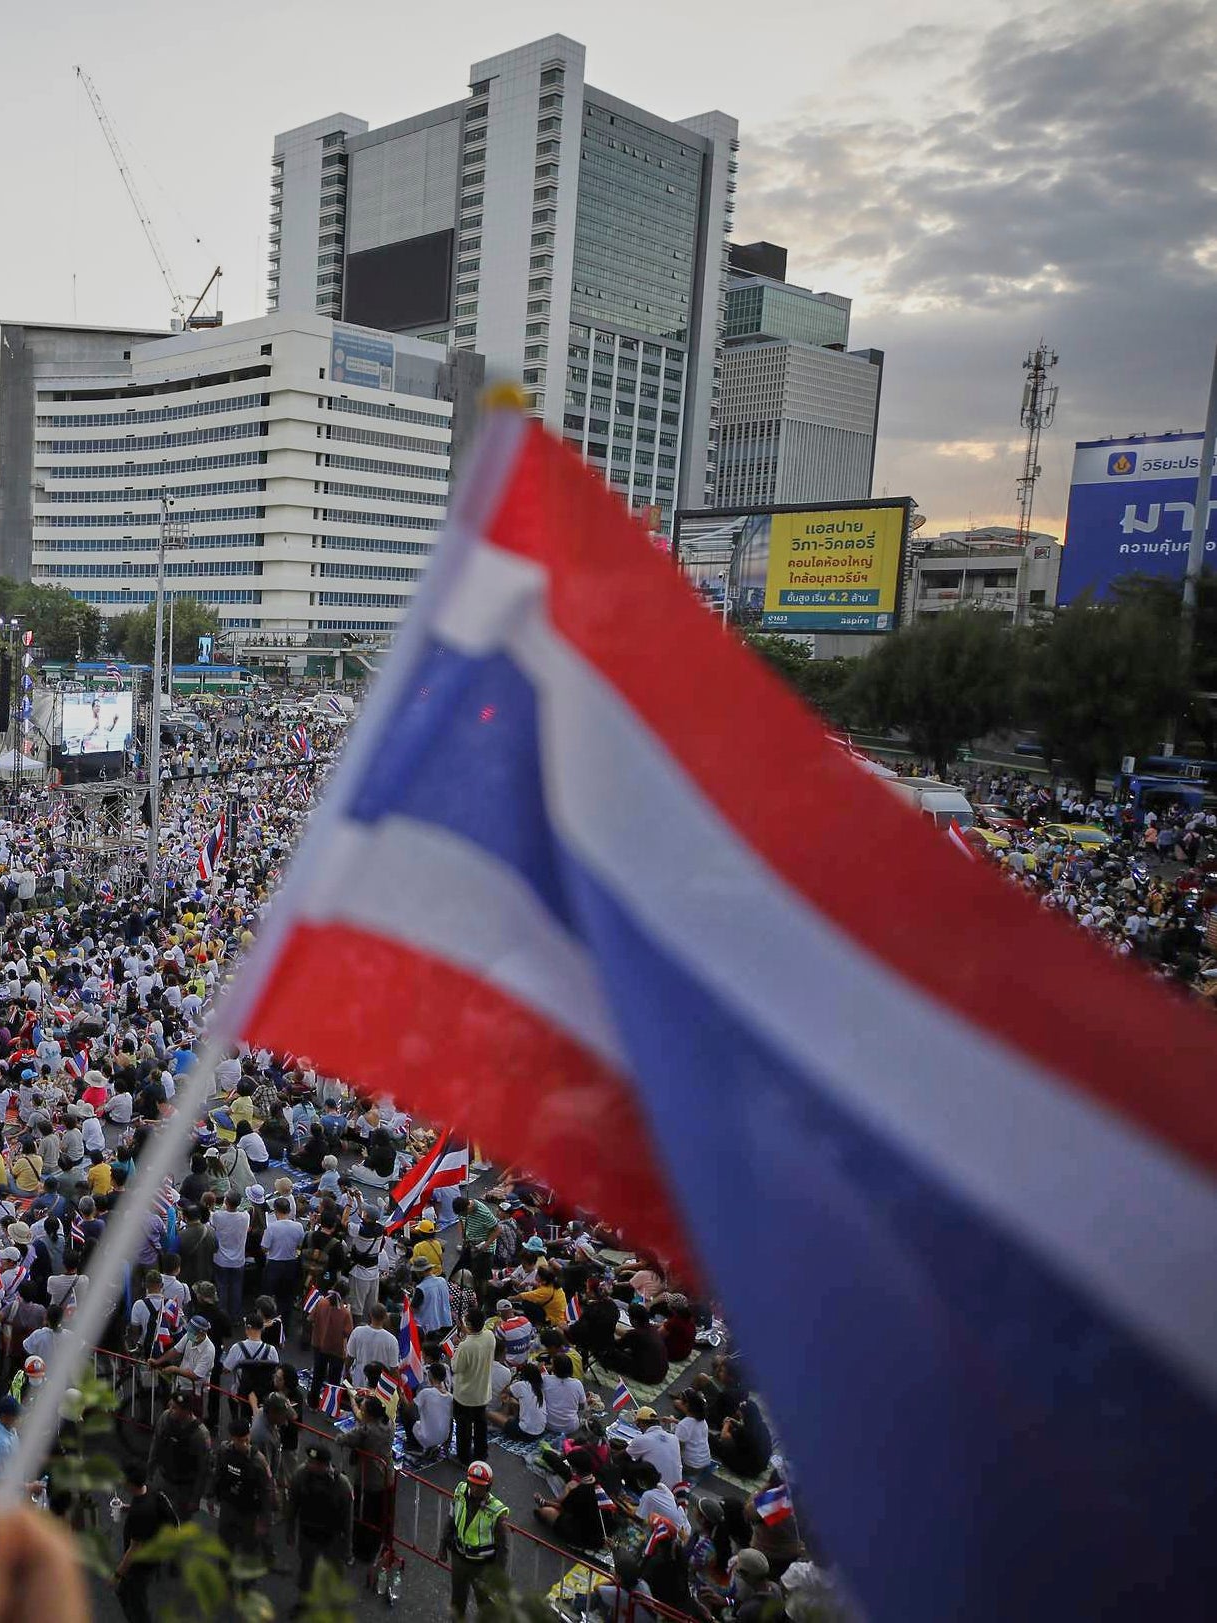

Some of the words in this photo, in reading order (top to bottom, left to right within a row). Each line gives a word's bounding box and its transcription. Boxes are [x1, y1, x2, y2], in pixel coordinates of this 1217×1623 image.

[1142, 455, 1217, 472] วิริยะปร
[1119, 500, 1217, 534] มา
[805, 520, 864, 535] แอสปาย
[791, 531, 876, 551] วิภา-วิคตอรี่
[787, 555, 873, 569] คอนโดห้องใหญ่
[789, 571, 868, 587] ใกล้อนุสาวรีย์ฯ
[827, 592, 849, 603] 4.2
[840, 615, 870, 625] aspire
